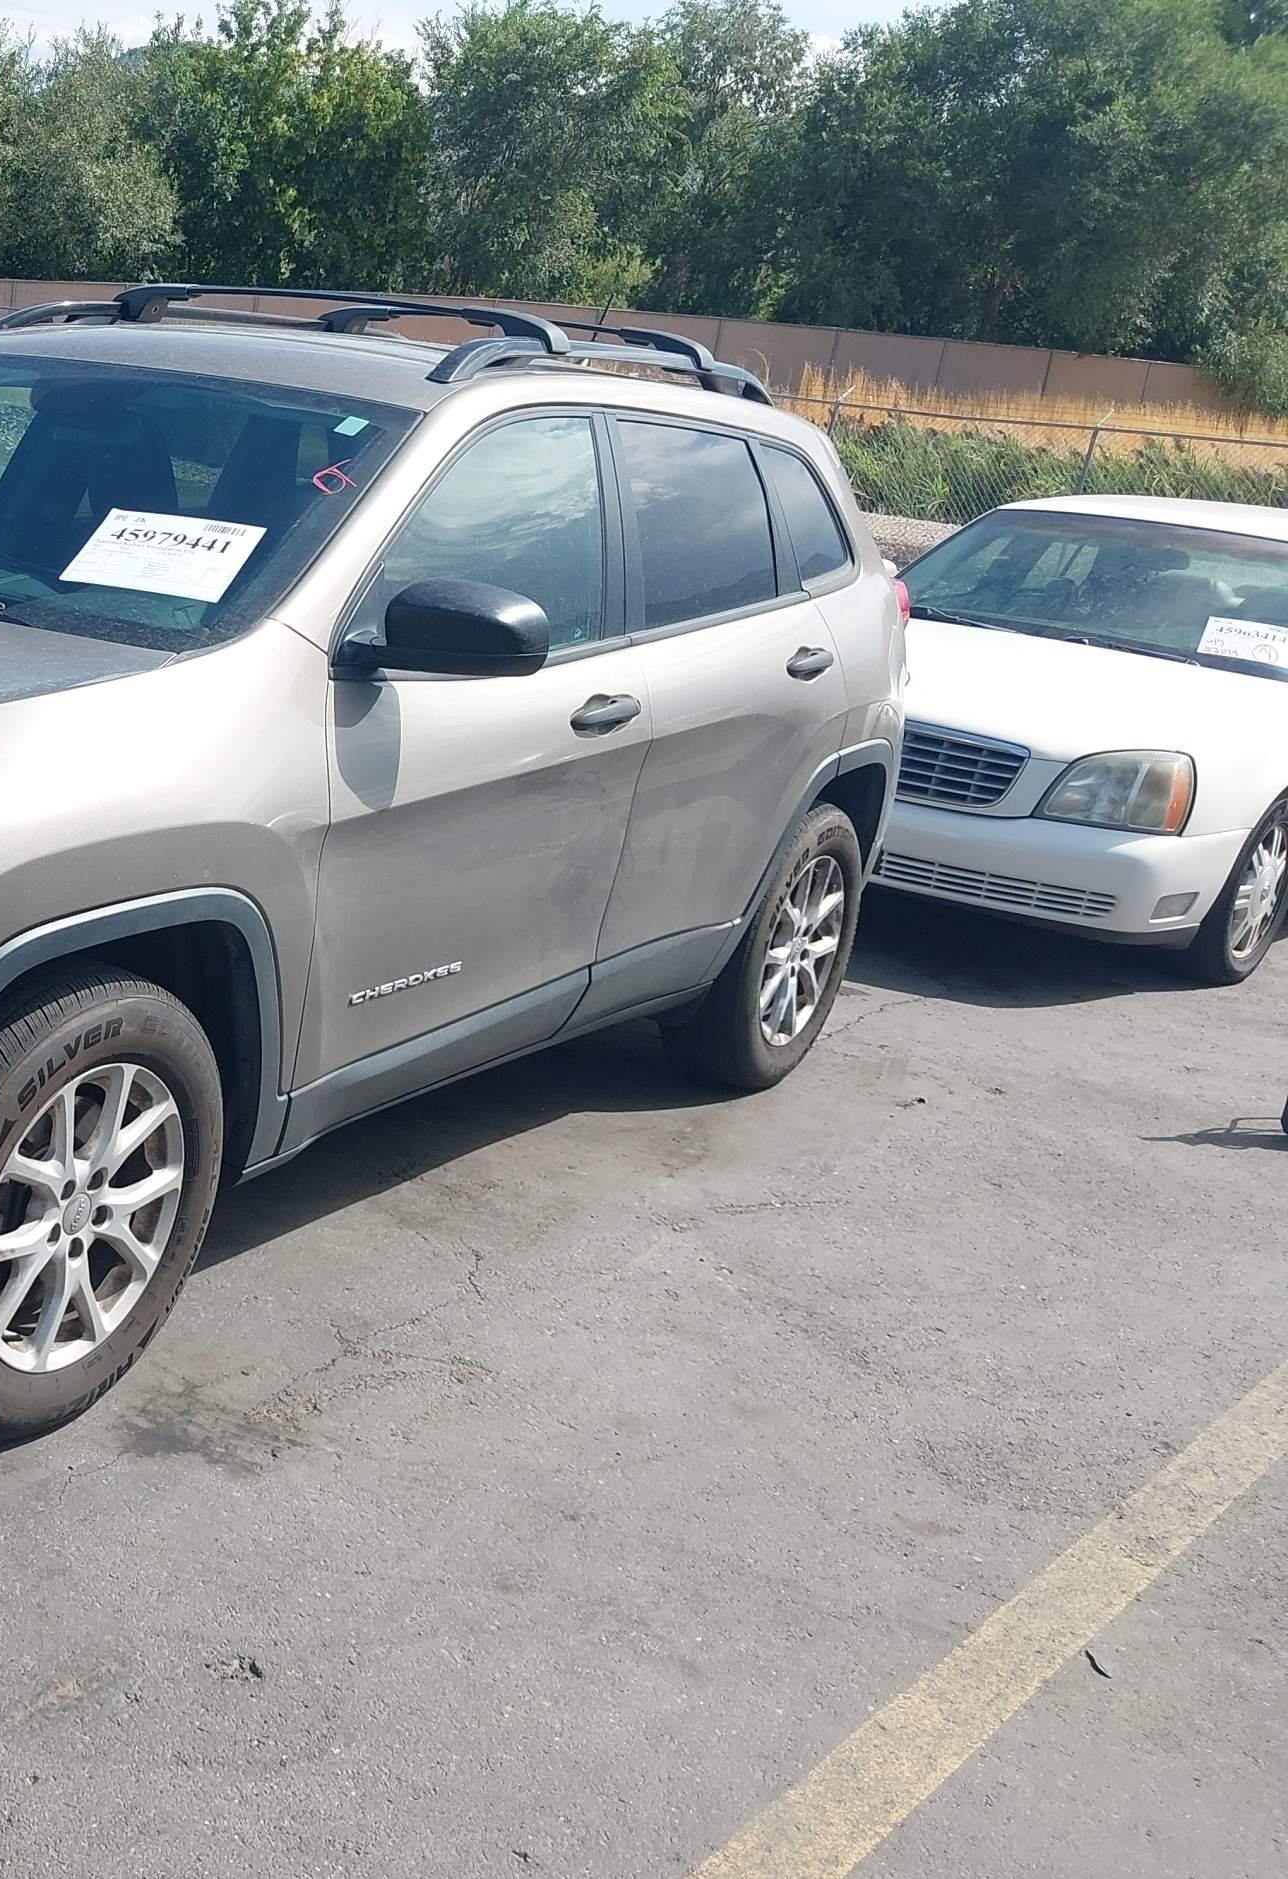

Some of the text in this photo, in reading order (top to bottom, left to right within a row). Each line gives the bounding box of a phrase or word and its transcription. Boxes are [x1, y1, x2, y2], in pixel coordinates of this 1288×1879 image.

[109, 526, 232, 554] 45979441
[349, 960, 463, 1006] CHEROKEE
[17, 1015, 124, 1112] SILVER
